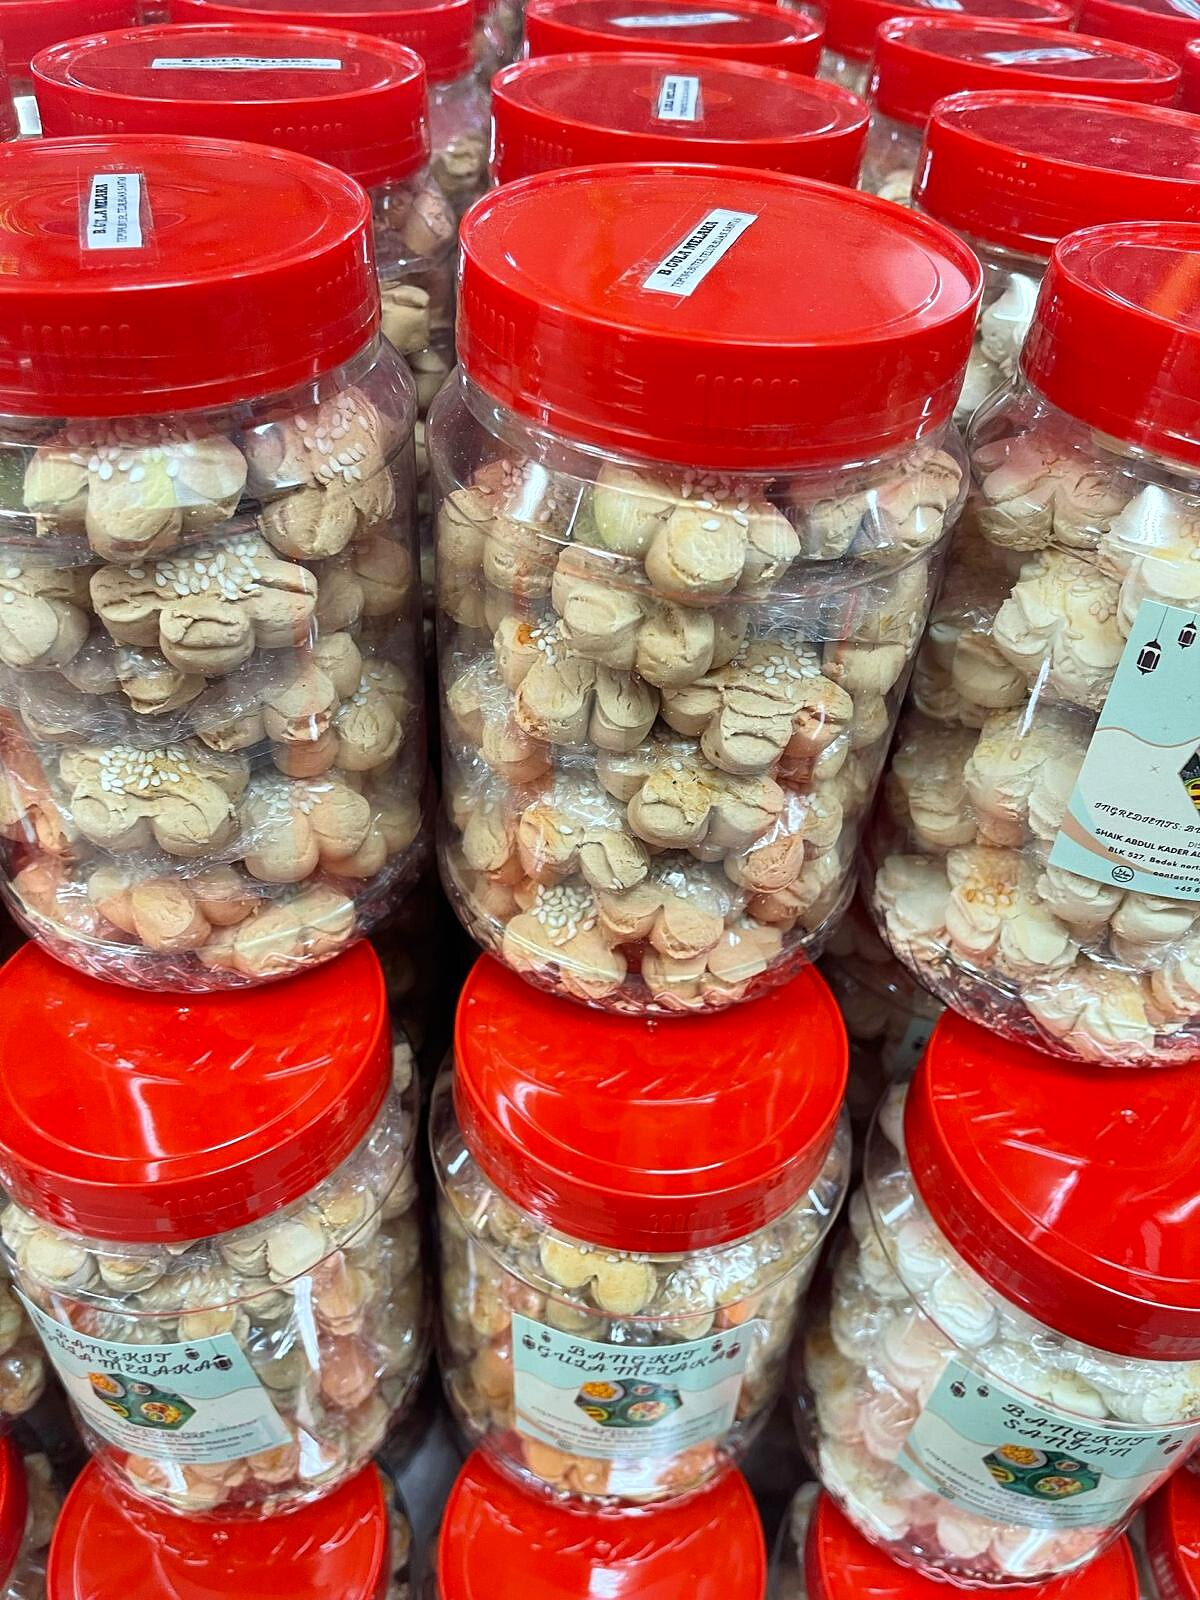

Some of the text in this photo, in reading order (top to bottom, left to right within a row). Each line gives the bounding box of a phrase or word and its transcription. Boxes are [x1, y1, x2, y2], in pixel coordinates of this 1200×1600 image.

[656, 221, 719, 276] B.GULA MELAKA
[1094, 802, 1182, 830] INGREDIENTS:
[1095, 828, 1124, 842] SHAIK
[1124, 837, 1156, 850] ABDUL
[1157, 845, 1189, 857] KADER
[1108, 846, 1125, 856] BLK
[1149, 856, 1178, 867] Bedok
[98, 1358, 214, 1377] MELAKA
[537, 1345, 727, 1377] GULA MELAKA
[568, 1344, 701, 1367] BANGKIT
[1001, 1403, 1153, 1446] BANGKIT
[1003, 1418, 1133, 1458] SANTAN
